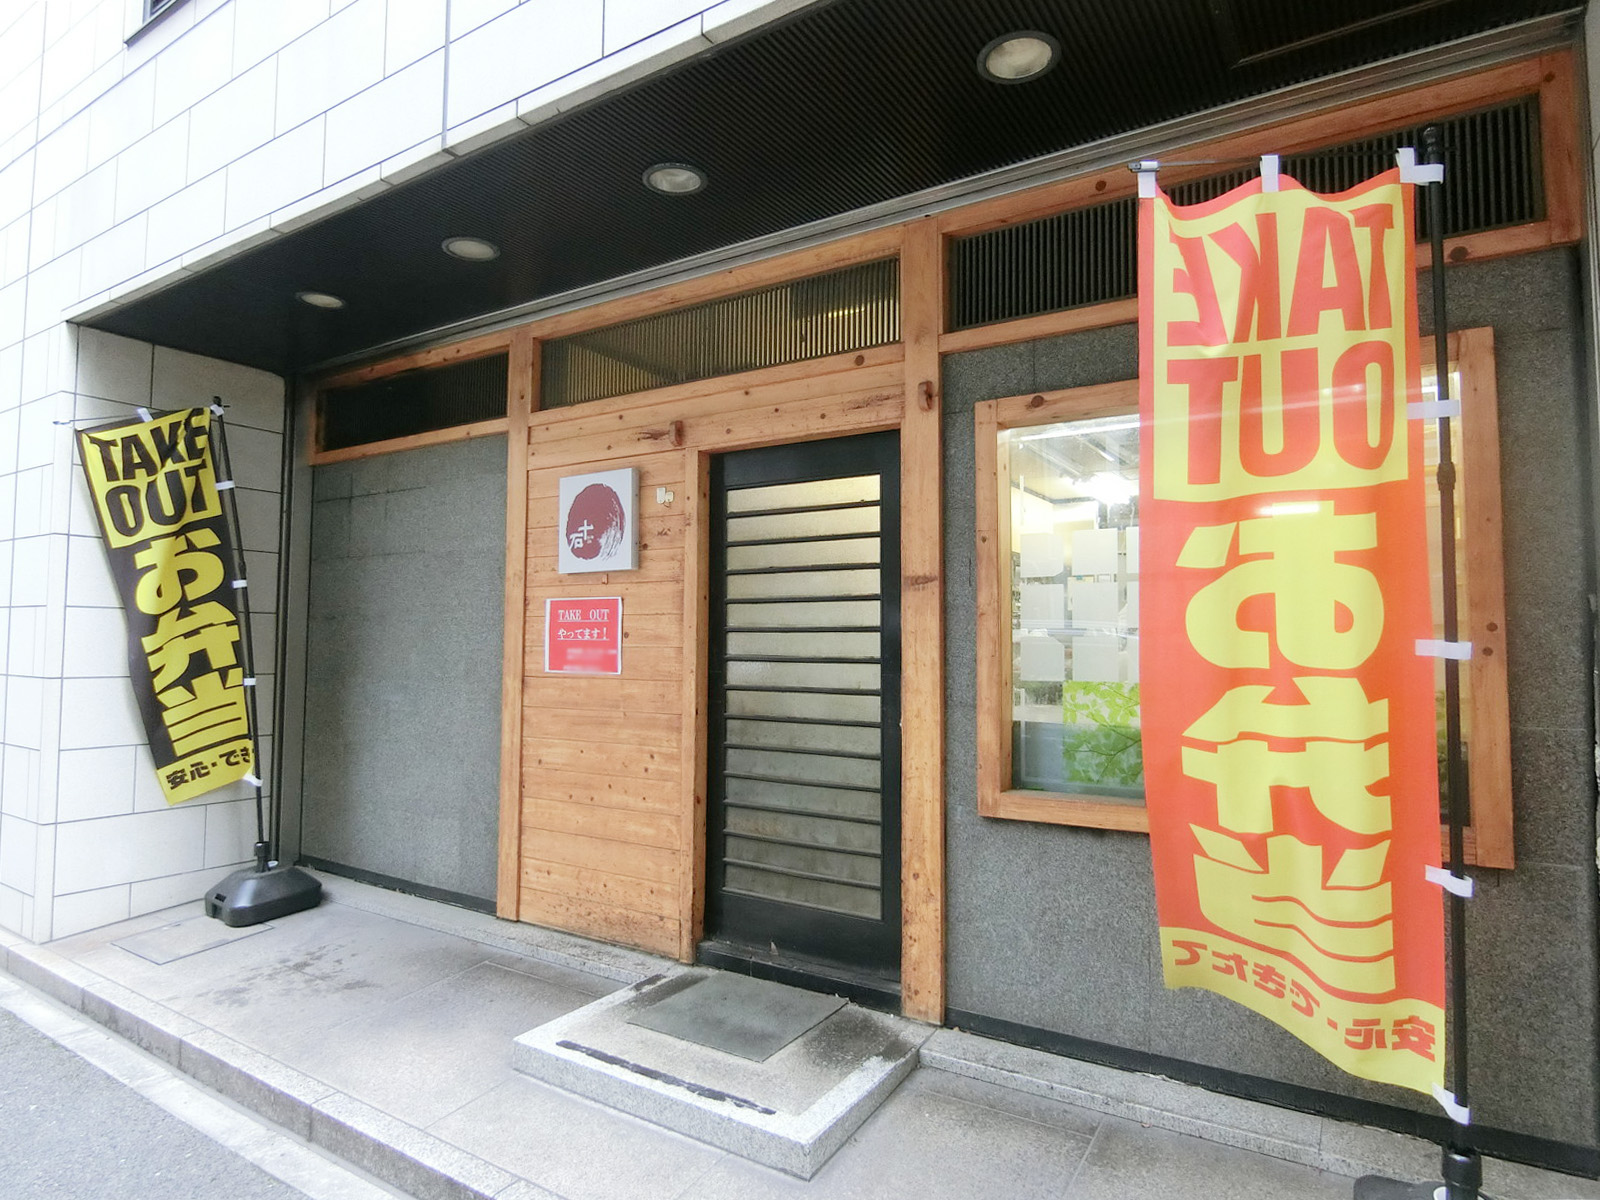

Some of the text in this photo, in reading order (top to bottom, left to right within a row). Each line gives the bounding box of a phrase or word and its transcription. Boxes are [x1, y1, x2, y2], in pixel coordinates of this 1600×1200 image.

[89, 407, 208, 483] TAKE
[105, 459, 208, 537] OUT
[134, 527, 249, 757] お弁当
[558, 609, 610, 621] TAKE OUT
